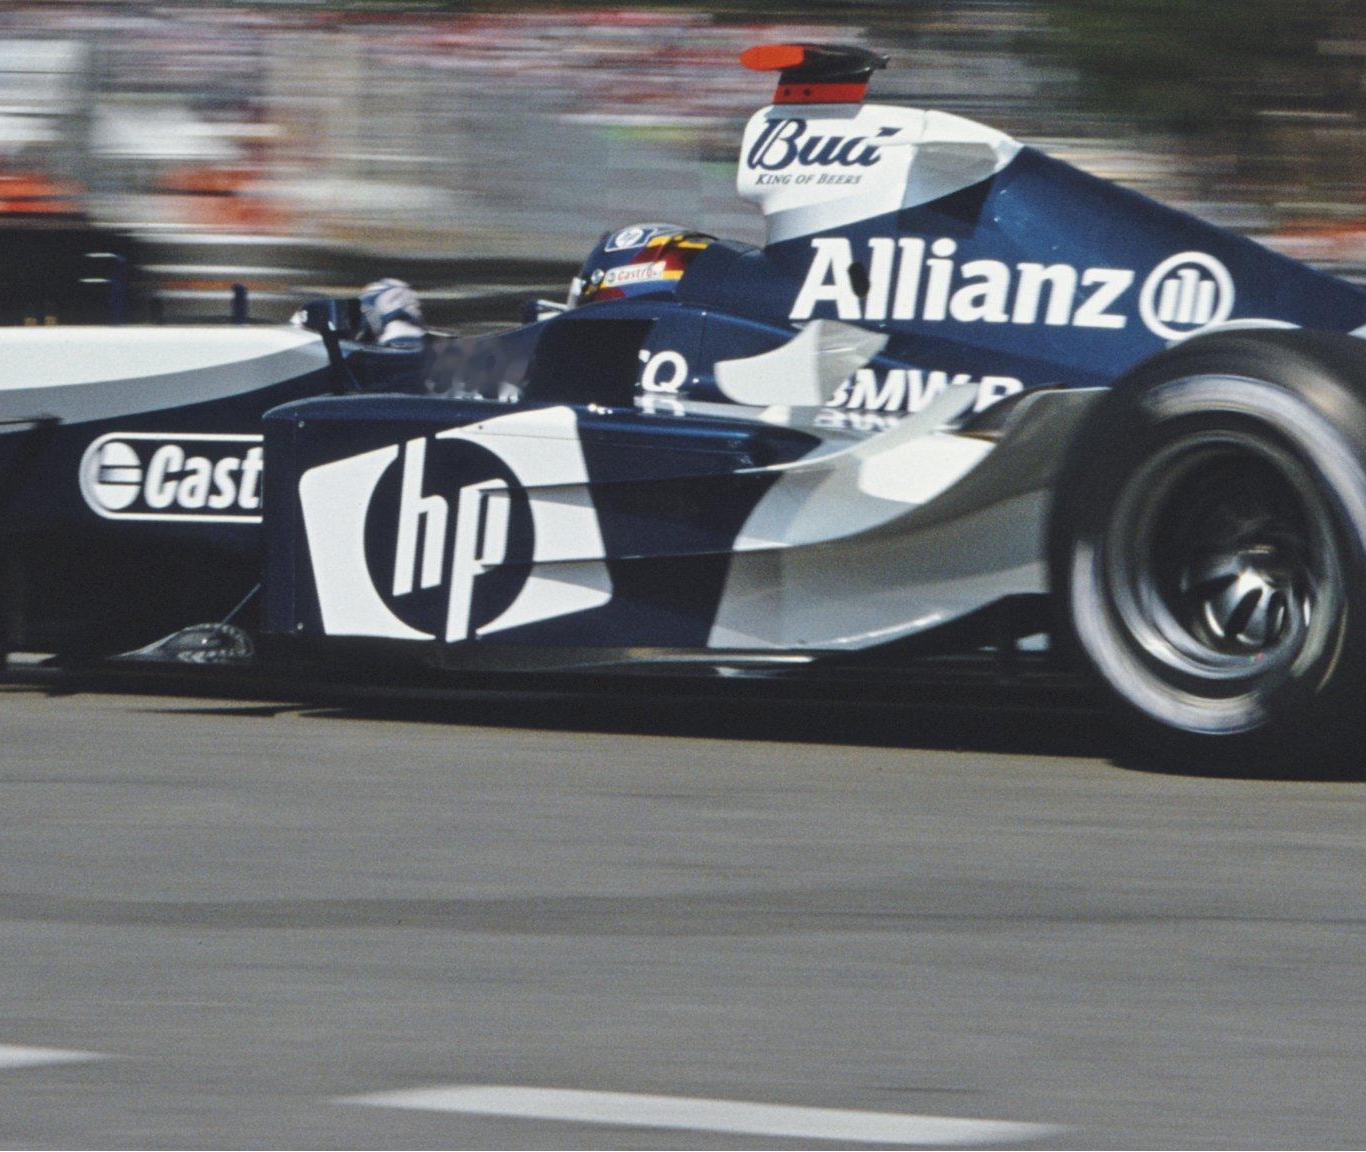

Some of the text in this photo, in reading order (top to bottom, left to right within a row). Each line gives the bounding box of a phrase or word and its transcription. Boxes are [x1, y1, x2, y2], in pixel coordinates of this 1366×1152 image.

[747, 118, 903, 171] Bud
[754, 173, 864, 186] KING OF BEERS
[788, 236, 1135, 329] Allianz
[391, 436, 512, 644] hp
